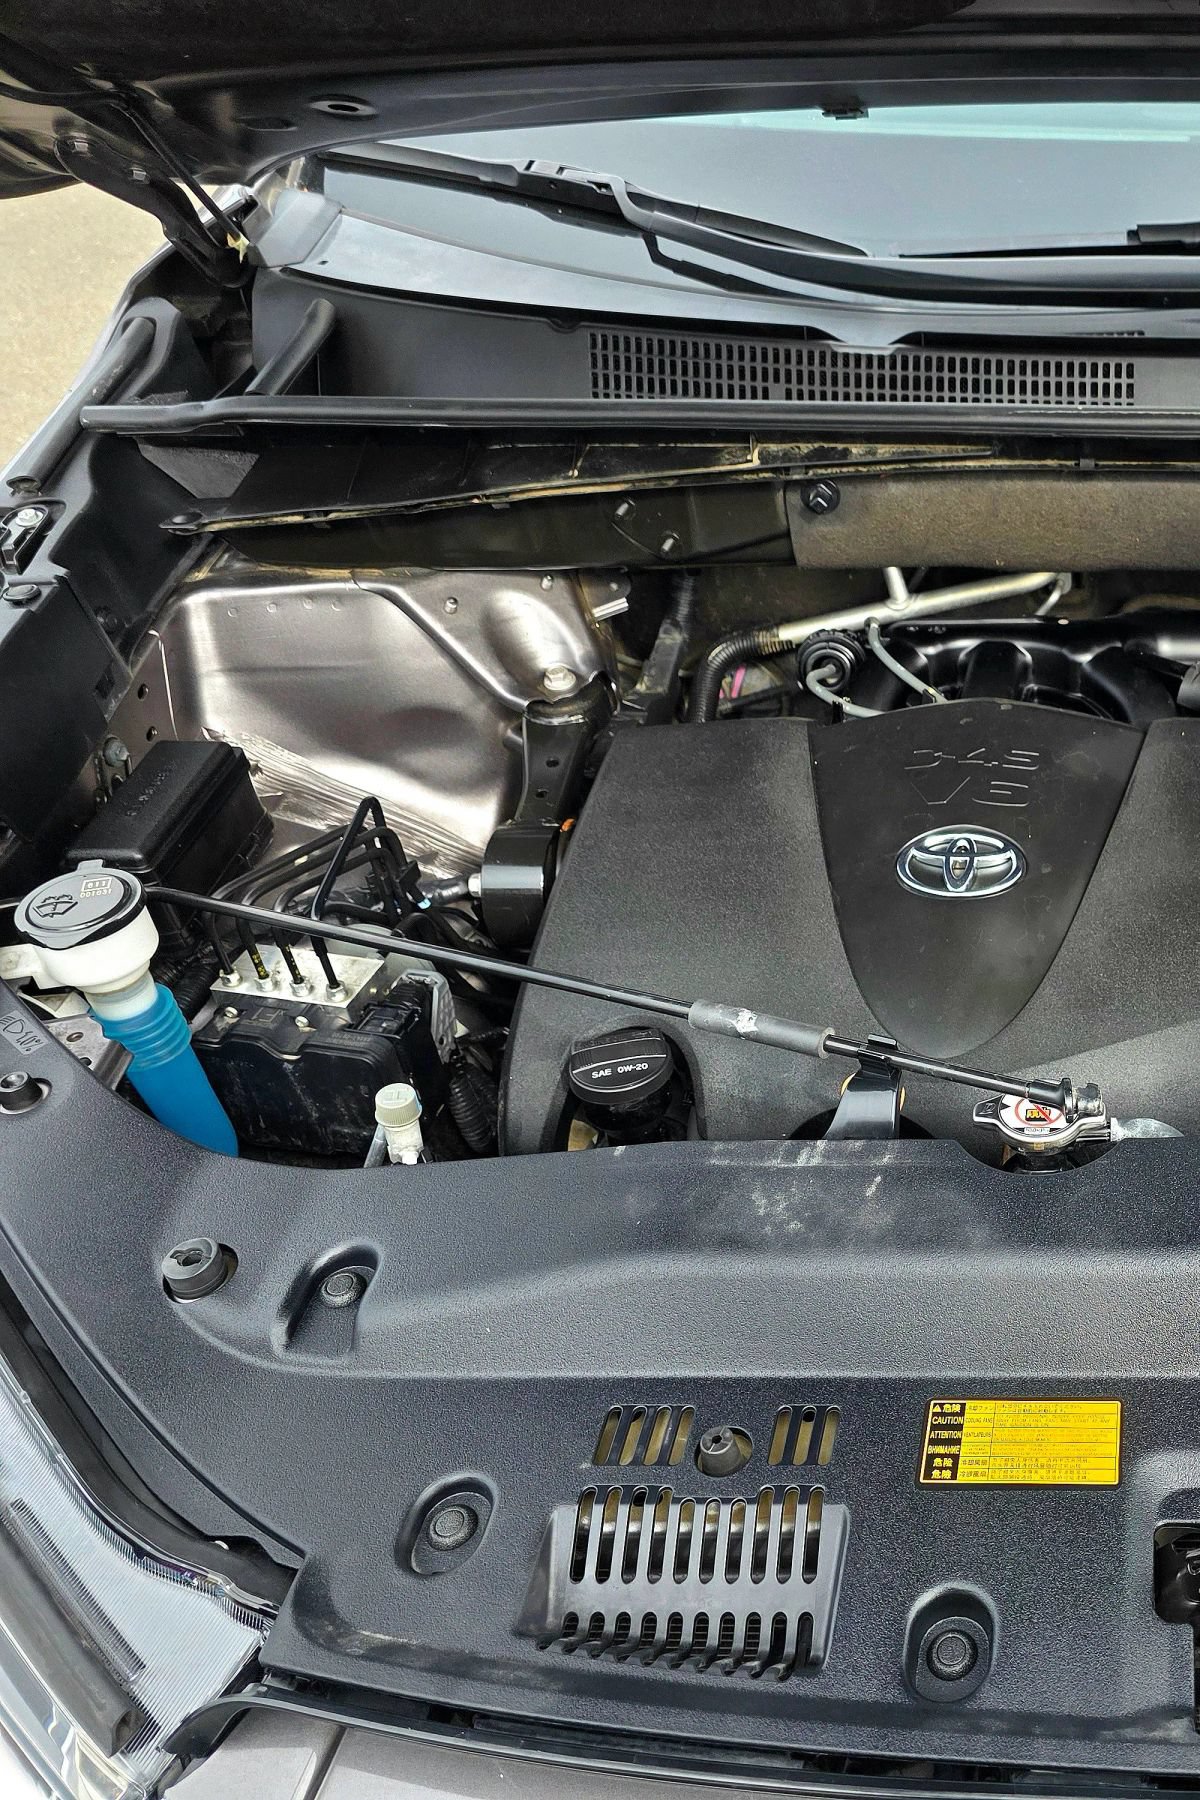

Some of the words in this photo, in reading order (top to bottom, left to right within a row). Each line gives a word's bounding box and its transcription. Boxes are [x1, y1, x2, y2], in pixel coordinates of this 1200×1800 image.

[591, 1068, 612, 1079] SAE
[617, 1063, 649, 1074] 0W-20
[932, 1416, 963, 1424] CAUTION
[930, 1430, 962, 1438] ATTENTION
